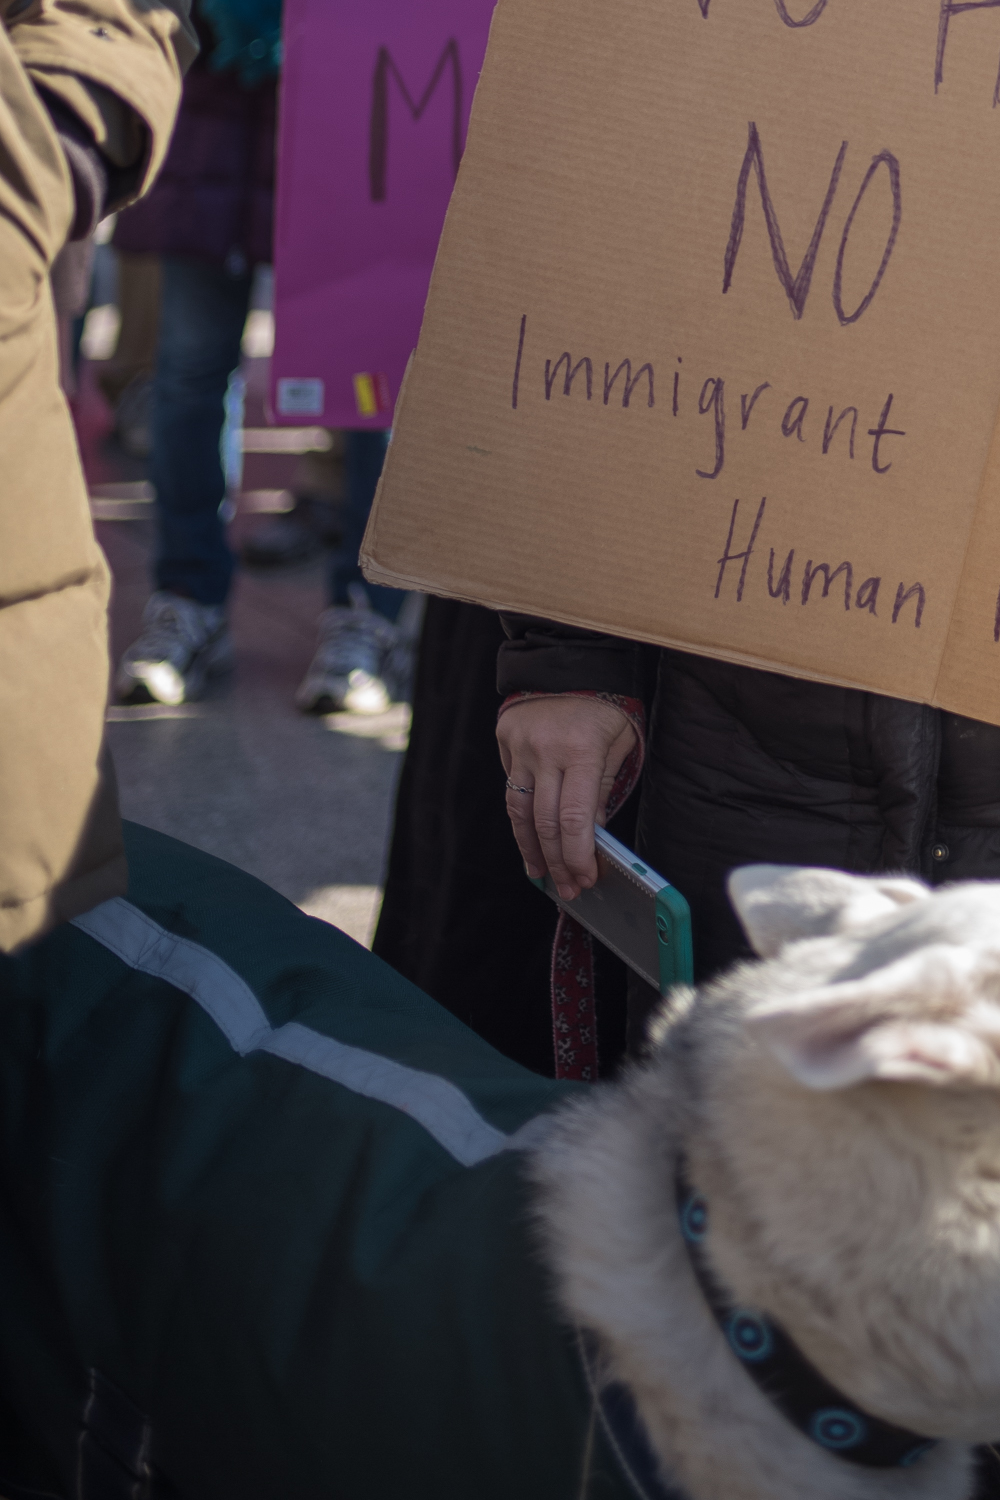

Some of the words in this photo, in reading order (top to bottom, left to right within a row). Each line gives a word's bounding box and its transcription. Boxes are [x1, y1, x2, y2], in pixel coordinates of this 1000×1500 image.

[722, 121, 901, 326] NO
[512, 313, 906, 479] Immigrant
[713, 496, 927, 628] Human
